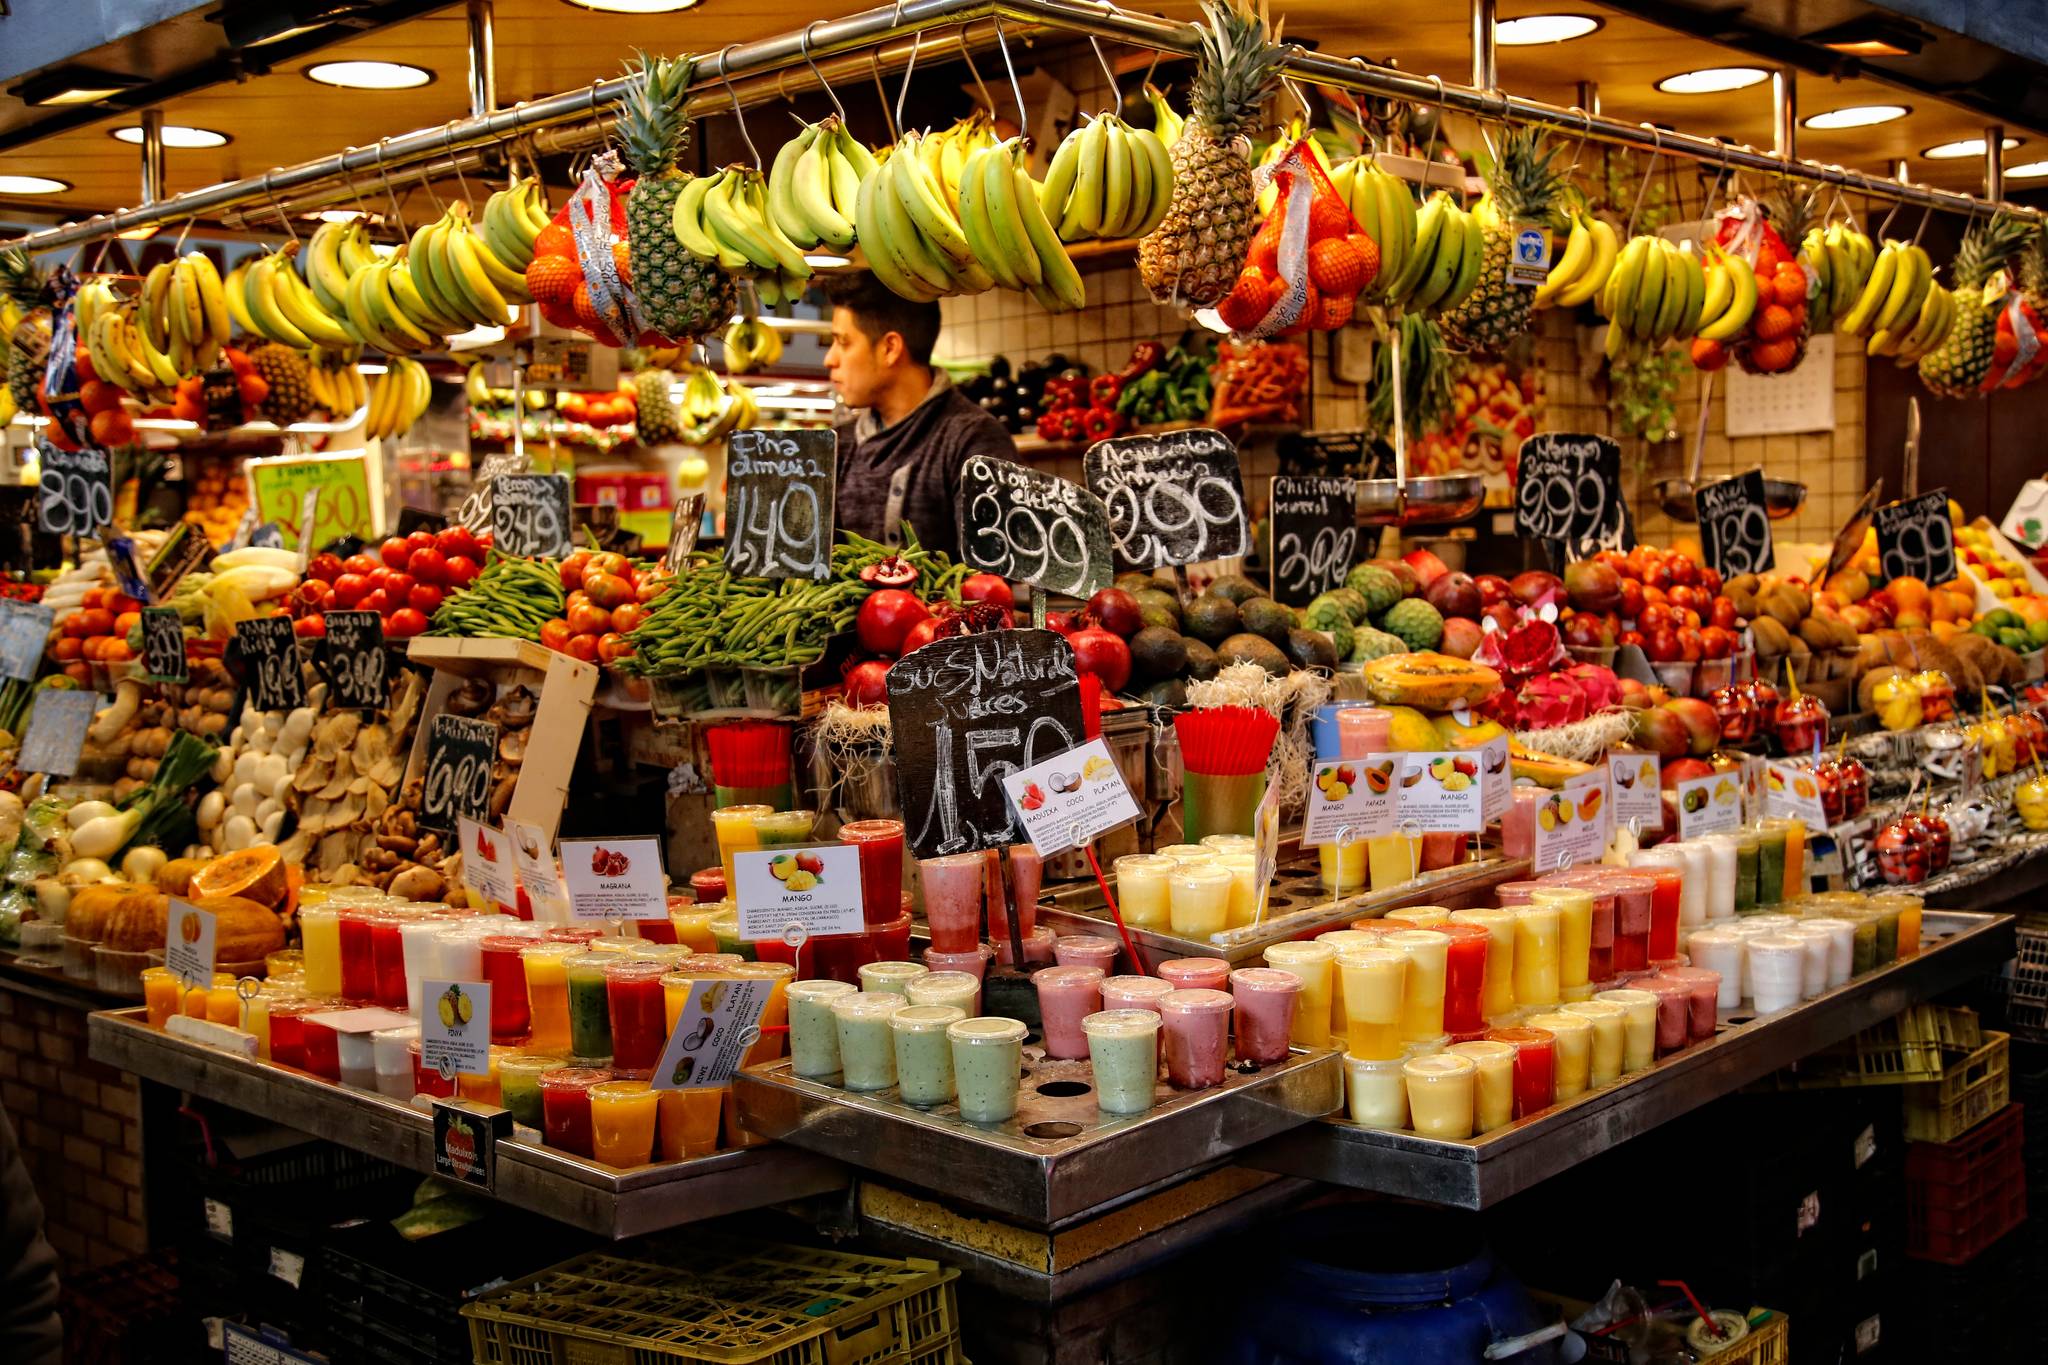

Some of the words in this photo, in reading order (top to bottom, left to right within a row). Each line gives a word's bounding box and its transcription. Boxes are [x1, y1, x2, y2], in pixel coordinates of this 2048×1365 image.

[1441, 793, 1469, 801] MANGO
[1026, 806, 1059, 825] MADUIXA
[1066, 795, 1085, 808] COCO
[1093, 779, 1121, 796] PLATAN
[1322, 803, 1345, 812] MANGO
[782, 894, 813, 903] MANGO
[712, 1027, 725, 1048] COCO
